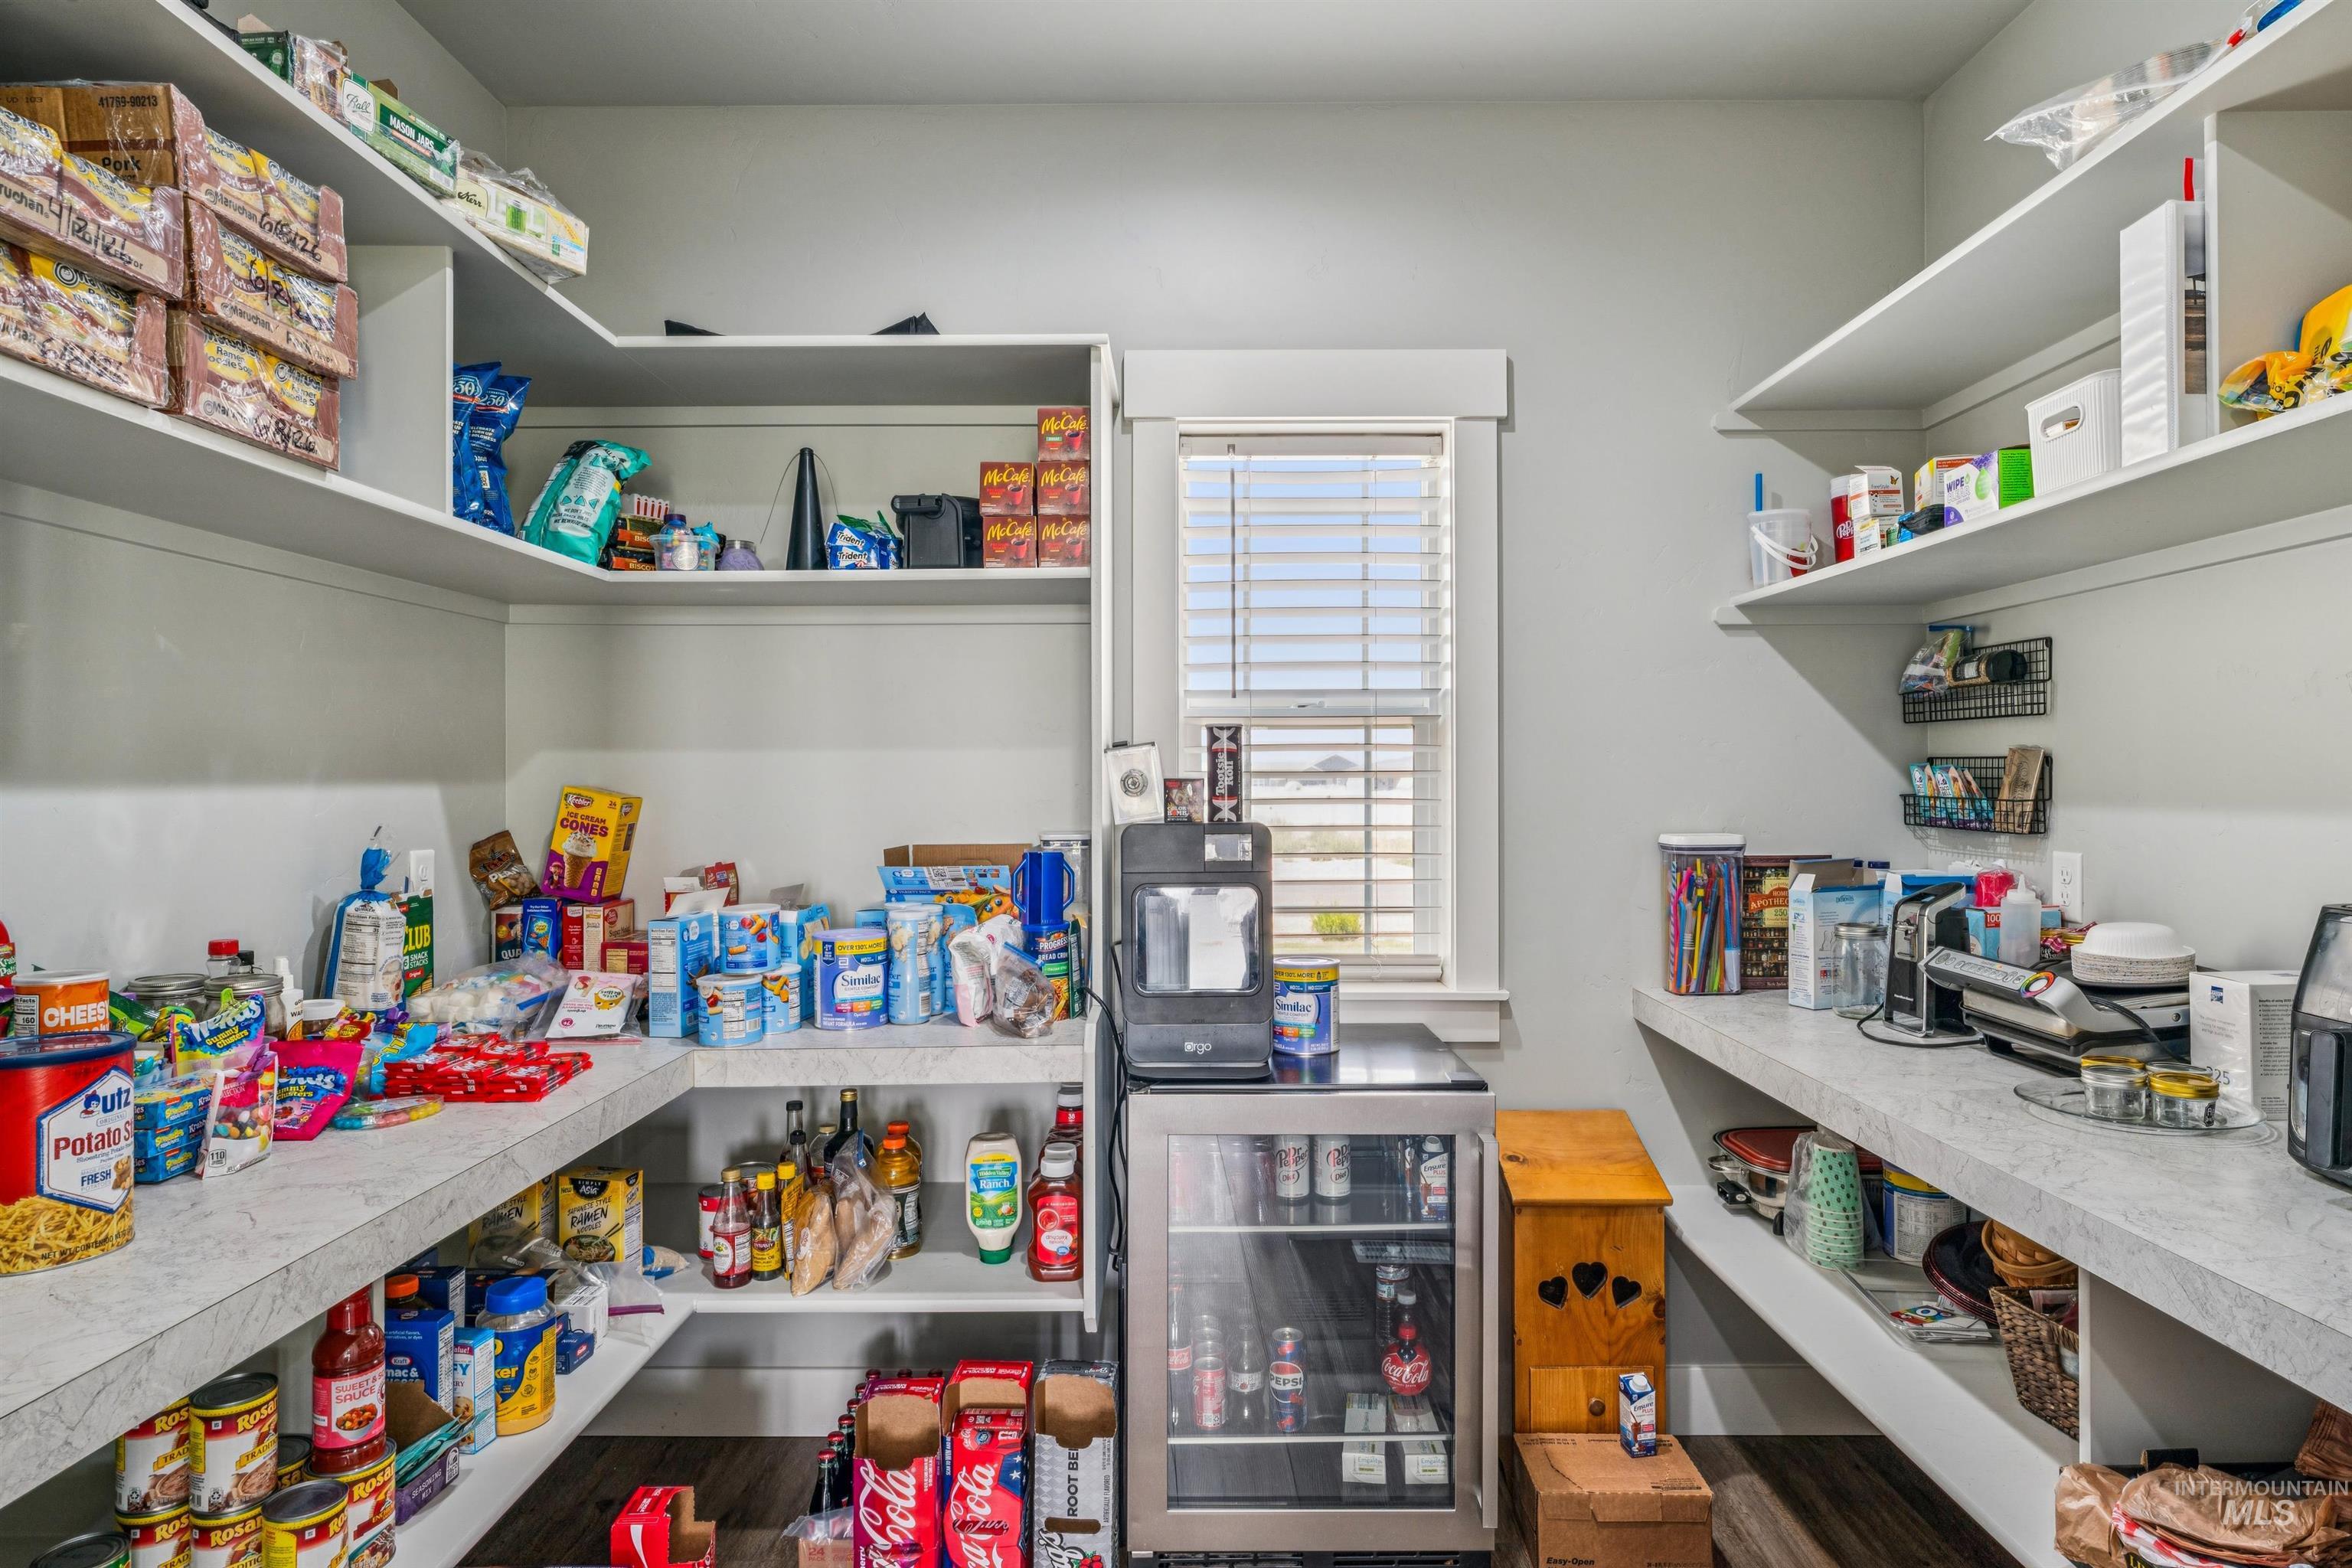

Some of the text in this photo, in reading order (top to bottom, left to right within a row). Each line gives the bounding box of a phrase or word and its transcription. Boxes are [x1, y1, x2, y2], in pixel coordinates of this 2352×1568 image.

[346, 93, 371, 113] Ball
[390, 115, 415, 140] MASON
[416, 132, 434, 151] JARS
[101, 156, 142, 172] Pork
[0, 183, 44, 216] ruchan
[216, 191, 257, 224] Maruchan
[458, 191, 484, 208] Kerr
[231, 305, 273, 332] Maruchan
[208, 353, 237, 369] oodle
[216, 346, 246, 361] Ramen
[220, 380, 242, 396] Pork
[453, 381, 475, 396] 50
[479, 394, 505, 407] 250
[294, 413, 315, 430] Pork
[1041, 415, 1088, 434] McCafé
[471, 433, 497, 443] BOLDNESS
[984, 467, 1031, 486] McCafé
[1040, 467, 1086, 486] McCafé
[1946, 476, 1965, 492] WIPE
[987, 521, 1034, 541] McCafé
[1042, 521, 1088, 540] McCafé
[837, 531, 865, 547] Trident
[838, 550, 868, 561] Trident
[629, 563, 656, 571] BISCOT
[1216, 751, 1225, 797] Tootsie
[1225, 760, 1234, 787] Roll
[567, 794, 592, 808] Keebler
[567, 811, 606, 825] ICE CREAM
[560, 817, 609, 838] CONES
[1750, 897, 1788, 910] APOTHEC
[1987, 913, 2001, 923] 100
[403, 923, 431, 953] CLUB
[1040, 936, 1068, 950] PROGRES
[410, 951, 429, 962] SNACK
[501, 946, 522, 961] QUA
[410, 959, 429, 969] STACKS
[409, 970, 421, 978] Original
[841, 973, 881, 987] Similac
[290, 1009, 303, 1018] WAF
[1276, 998, 1312, 1013] Similac
[22, 1017, 35, 1025] 160
[205, 1025, 240, 1047] Gummy
[216, 1030, 249, 1050] Clusters
[101, 1087, 131, 1115] utz
[99, 1113, 126, 1126] ORIGINAL
[54, 1125, 121, 1161] Potato
[77, 1150, 110, 1164] Shoestring
[211, 1152, 225, 1161] 110
[1276, 1148, 1308, 1168] Pepper
[81, 1164, 111, 1177] MADE FROM
[1424, 1163, 1446, 1172] Ensure
[81, 1169, 111, 1187] FRESH
[980, 1179, 1010, 1189] Ranch
[1282, 1173, 1295, 1182] Diet
[1335, 1171, 1347, 1181] Diet
[579, 1185, 599, 1196] Asia
[511, 1194, 528, 1207] STYLE
[567, 1195, 612, 1217] JAPANESE STYLE
[482, 1204, 524, 1229] RAMEN
[570, 1204, 609, 1229] RAMEN
[577, 1222, 602, 1235] NOODLES
[41, 1250, 57, 1261] NET
[384, 1368, 419, 1378] mac &
[1381, 1354, 1429, 1384] Coca-Cola
[335, 1375, 377, 1394] SWEET &
[1270, 1374, 1304, 1387] PEPSI
[335, 1384, 376, 1404] SAUCE
[1633, 1400, 1654, 1413] Ensure
[237, 1396, 277, 1434] Rosar
[245, 1437, 277, 1462] TRADITI
[1358, 1456, 1380, 1465] Emgality
[352, 1463, 395, 1503] Rosar
[411, 1468, 443, 1500] SEASONING
[421, 1488, 433, 1501] MIX
[1067, 1475, 1080, 1518] ROOT
[210, 1515, 263, 1548] Rosar
[808, 1547, 825, 1557] 24
[1546, 1557, 1595, 1566] Easy-Open
